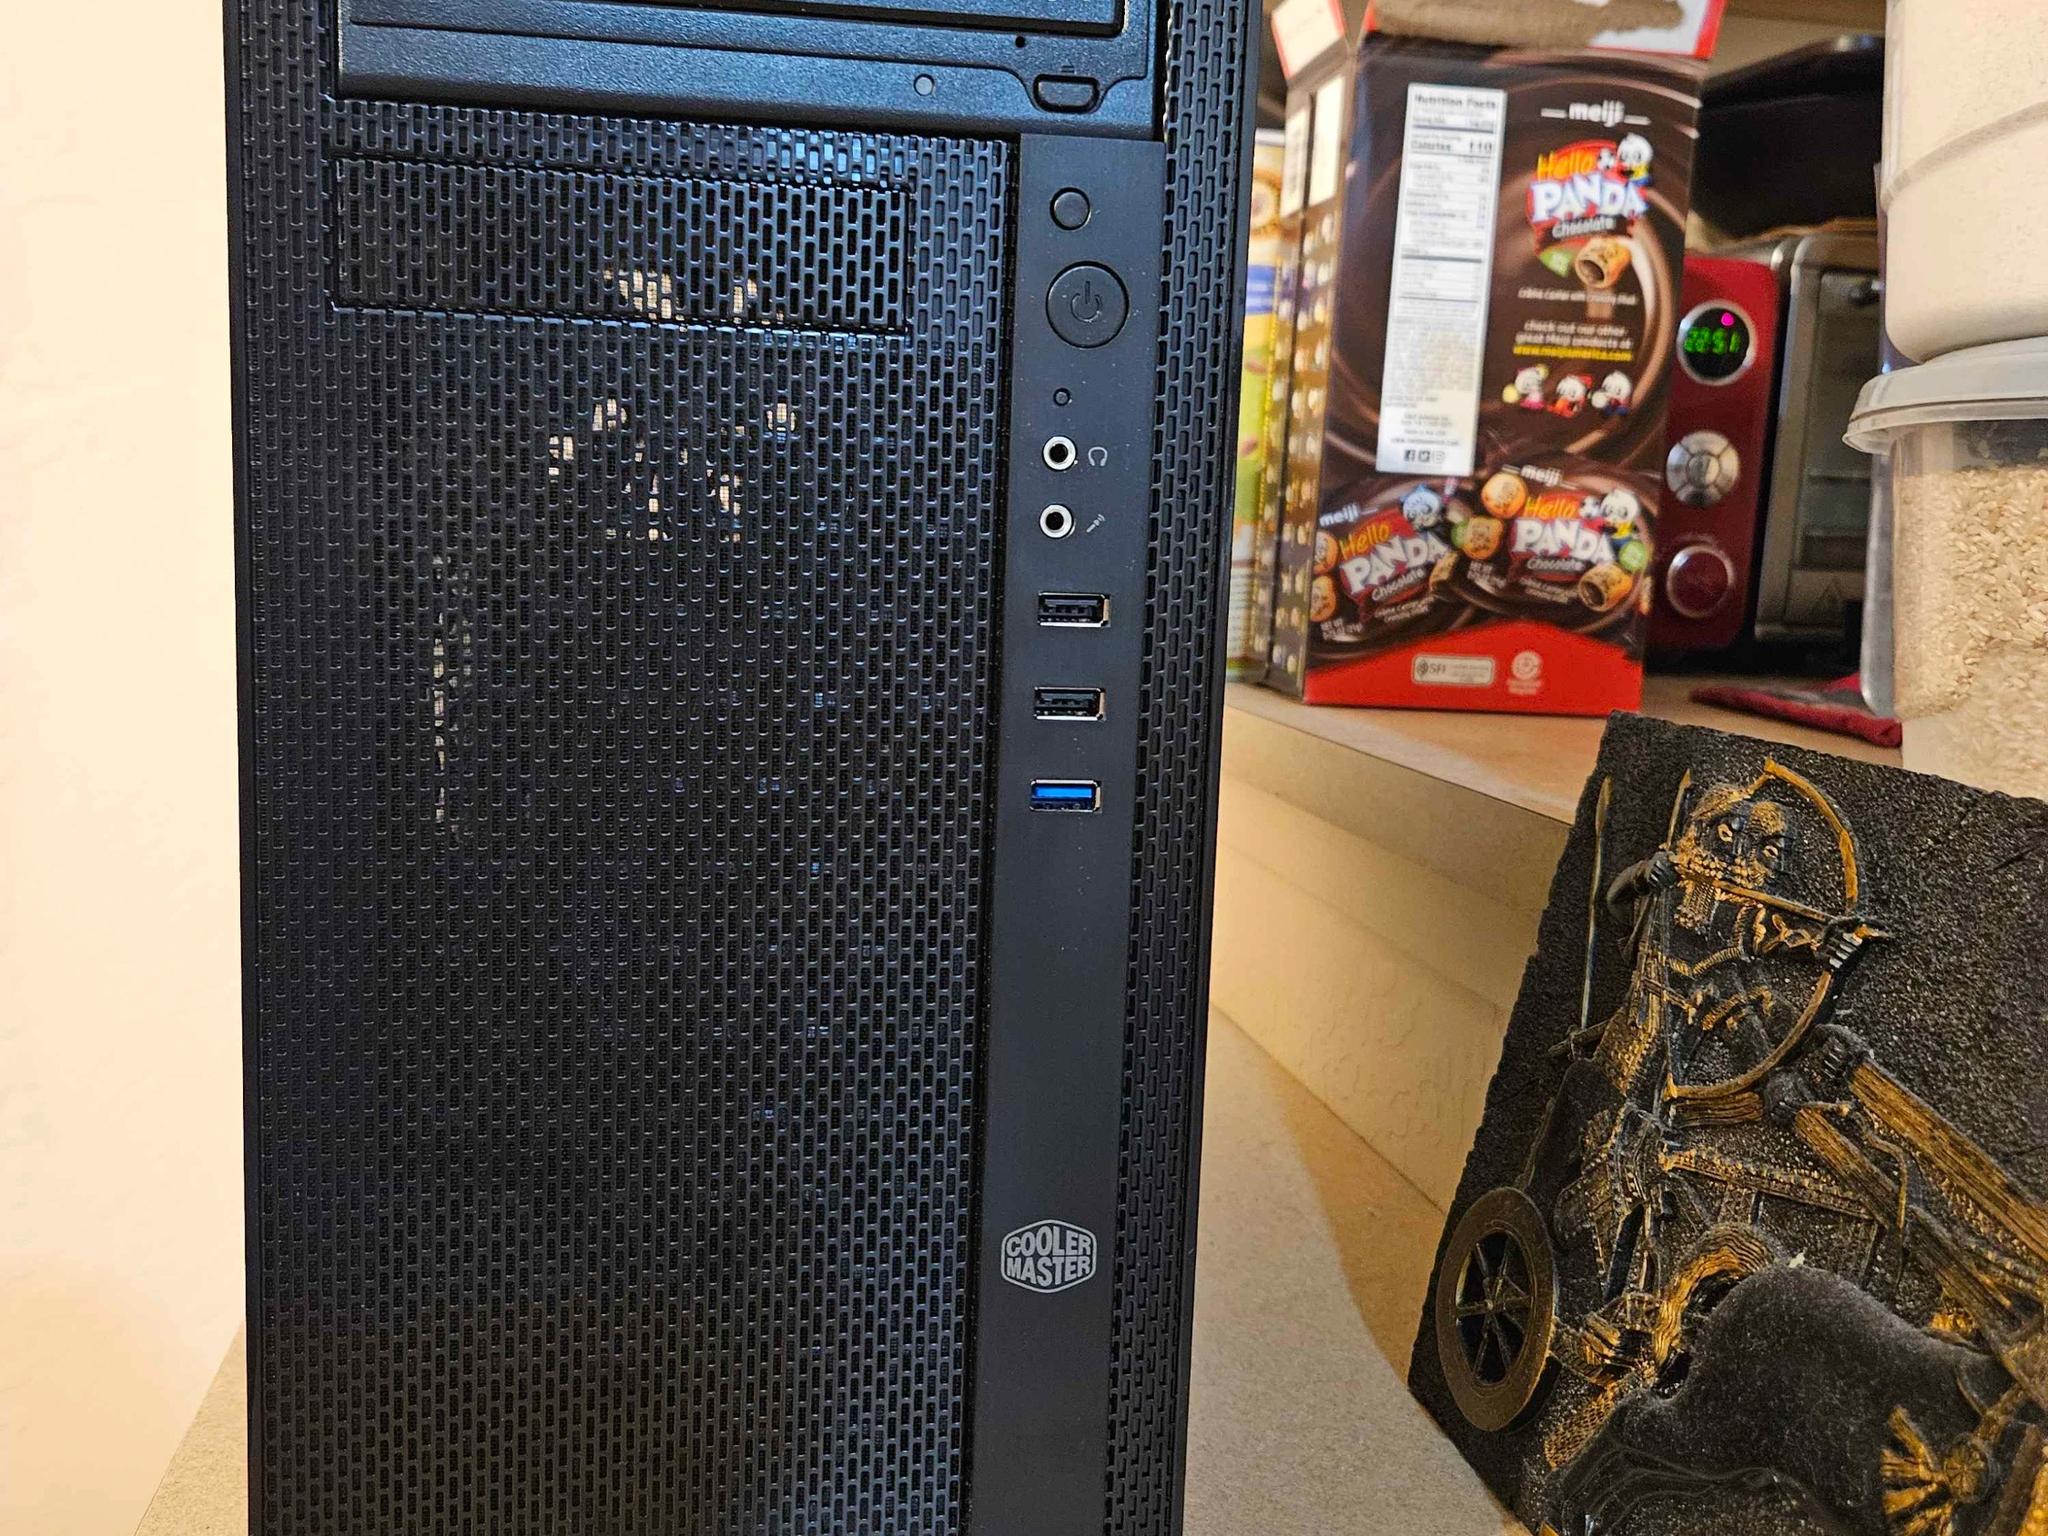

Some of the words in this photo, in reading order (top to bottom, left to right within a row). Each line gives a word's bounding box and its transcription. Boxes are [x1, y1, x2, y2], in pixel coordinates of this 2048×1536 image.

[1568, 99, 1625, 128] meiji
[1537, 150, 1598, 181] Hello
[1530, 172, 1649, 223] PANDA
[1551, 215, 1616, 239] Chocolate
[1520, 465, 1563, 487] meiji
[1319, 502, 1360, 527] meiji
[1523, 495, 1579, 520] Hello
[1339, 521, 1391, 560] Hello
[1512, 516, 1616, 563] PANDA
[1339, 531, 1448, 594] PANDA
[1371, 567, 1426, 601] Chocolate
[1006, 1225, 1092, 1257] COOLER
[1006, 1256, 1091, 1287] MASTER
